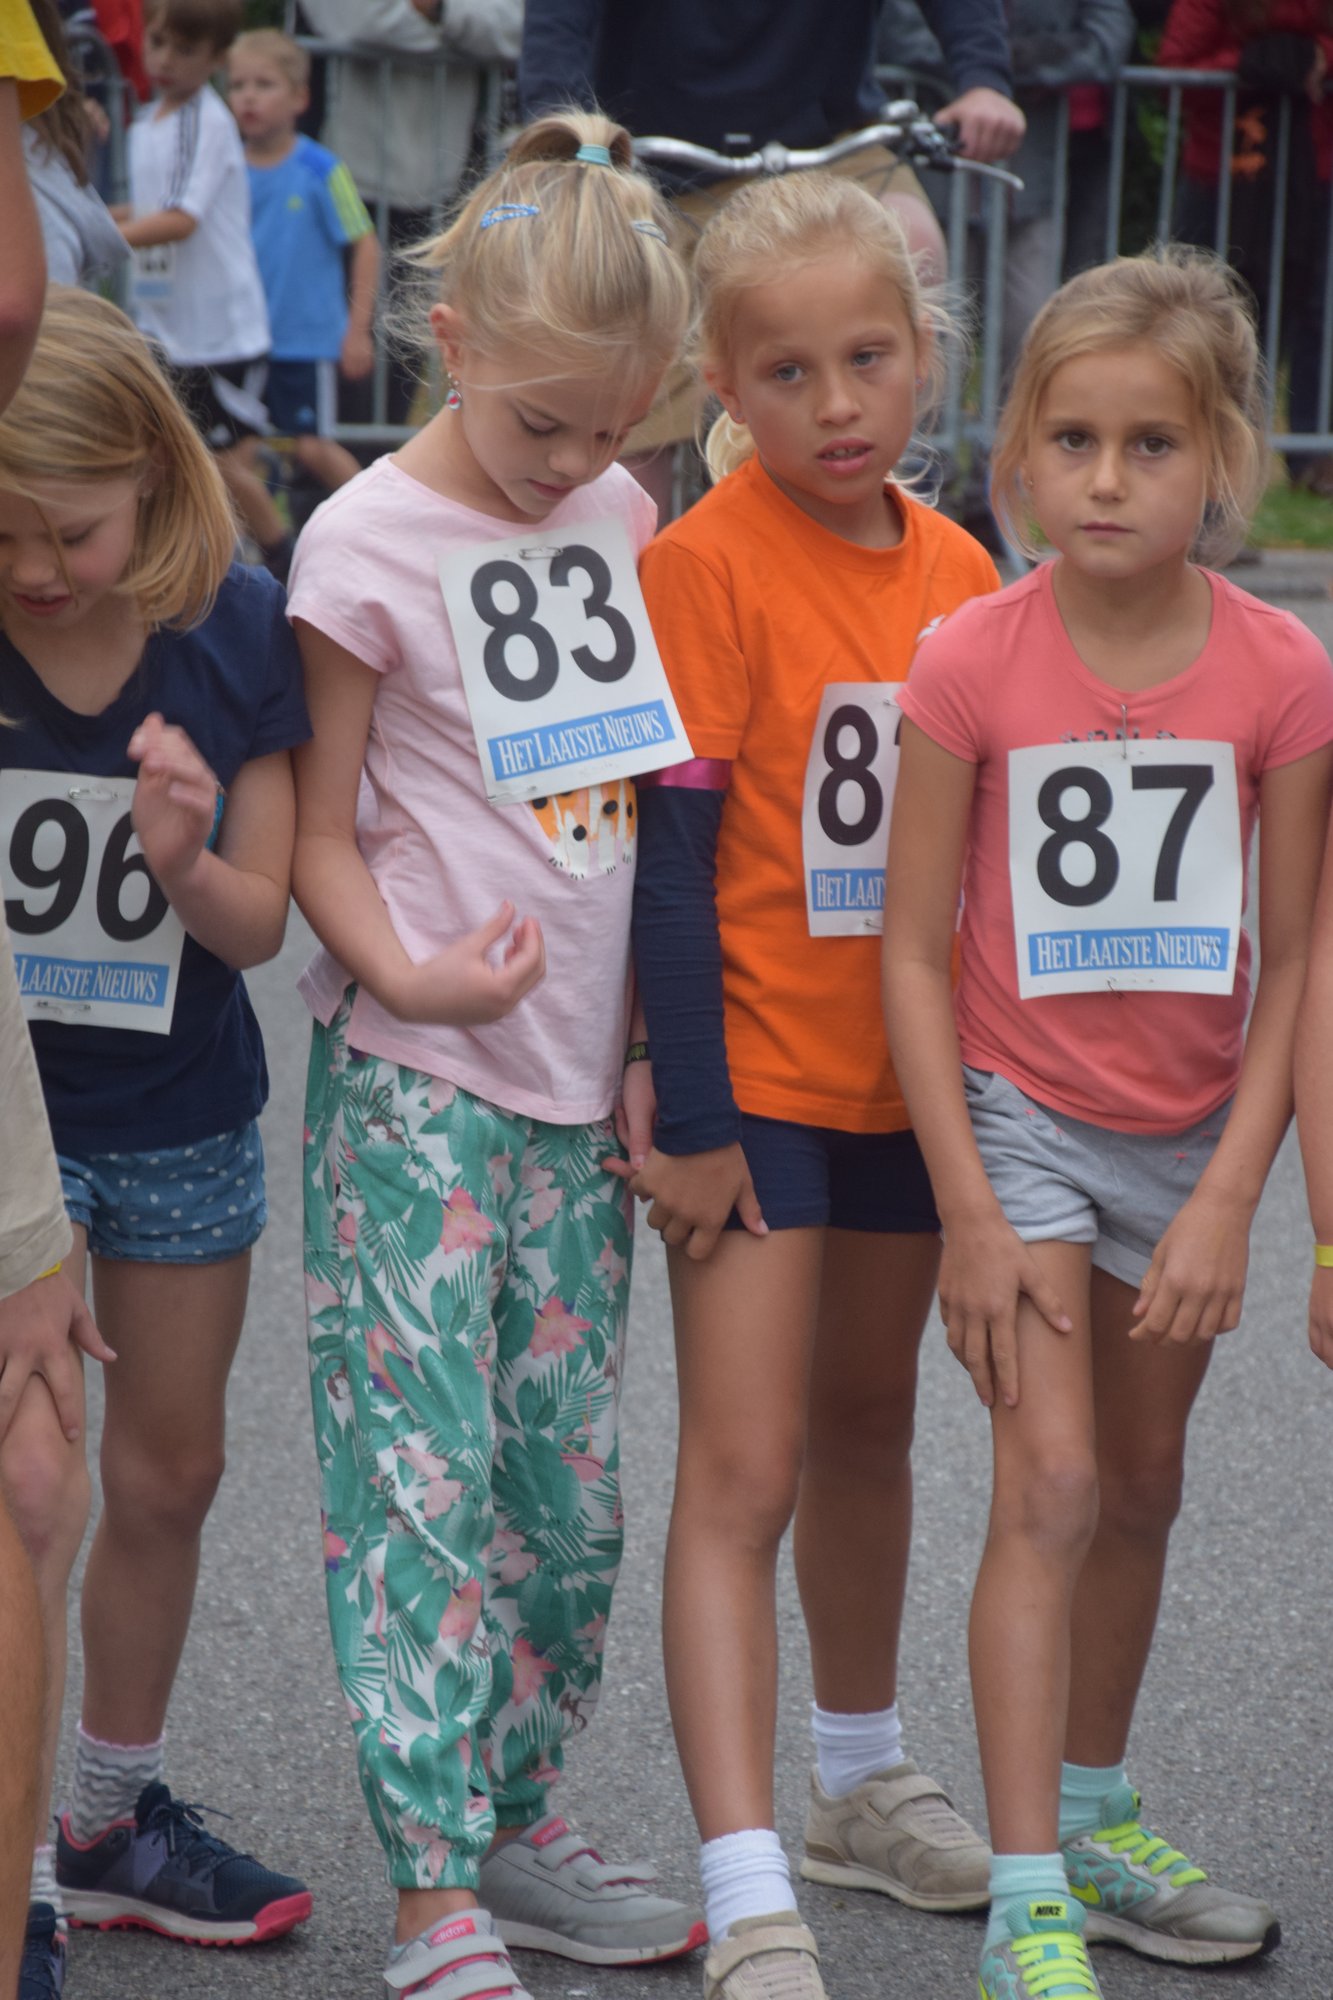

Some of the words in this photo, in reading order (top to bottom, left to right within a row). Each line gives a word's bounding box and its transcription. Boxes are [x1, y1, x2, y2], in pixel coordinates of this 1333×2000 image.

[470, 544, 636, 701] 83
[497, 738, 536, 775] HET
[533, 722, 607, 767] LAATSTE
[602, 709, 665, 752] NIEUWS
[818, 704, 904, 847] 8
[5, 798, 170, 942] 96
[1037, 764, 1214, 907] 87
[816, 873, 844, 907] HET
[845, 873, 886, 906] LAAT
[19, 958, 92, 996] LAATSTE
[92, 964, 158, 1003] NIEUWS
[1036, 935, 1073, 971] HET
[1075, 933, 1153, 968] LAATSTE
[1155, 931, 1222, 968] NIEUWS
